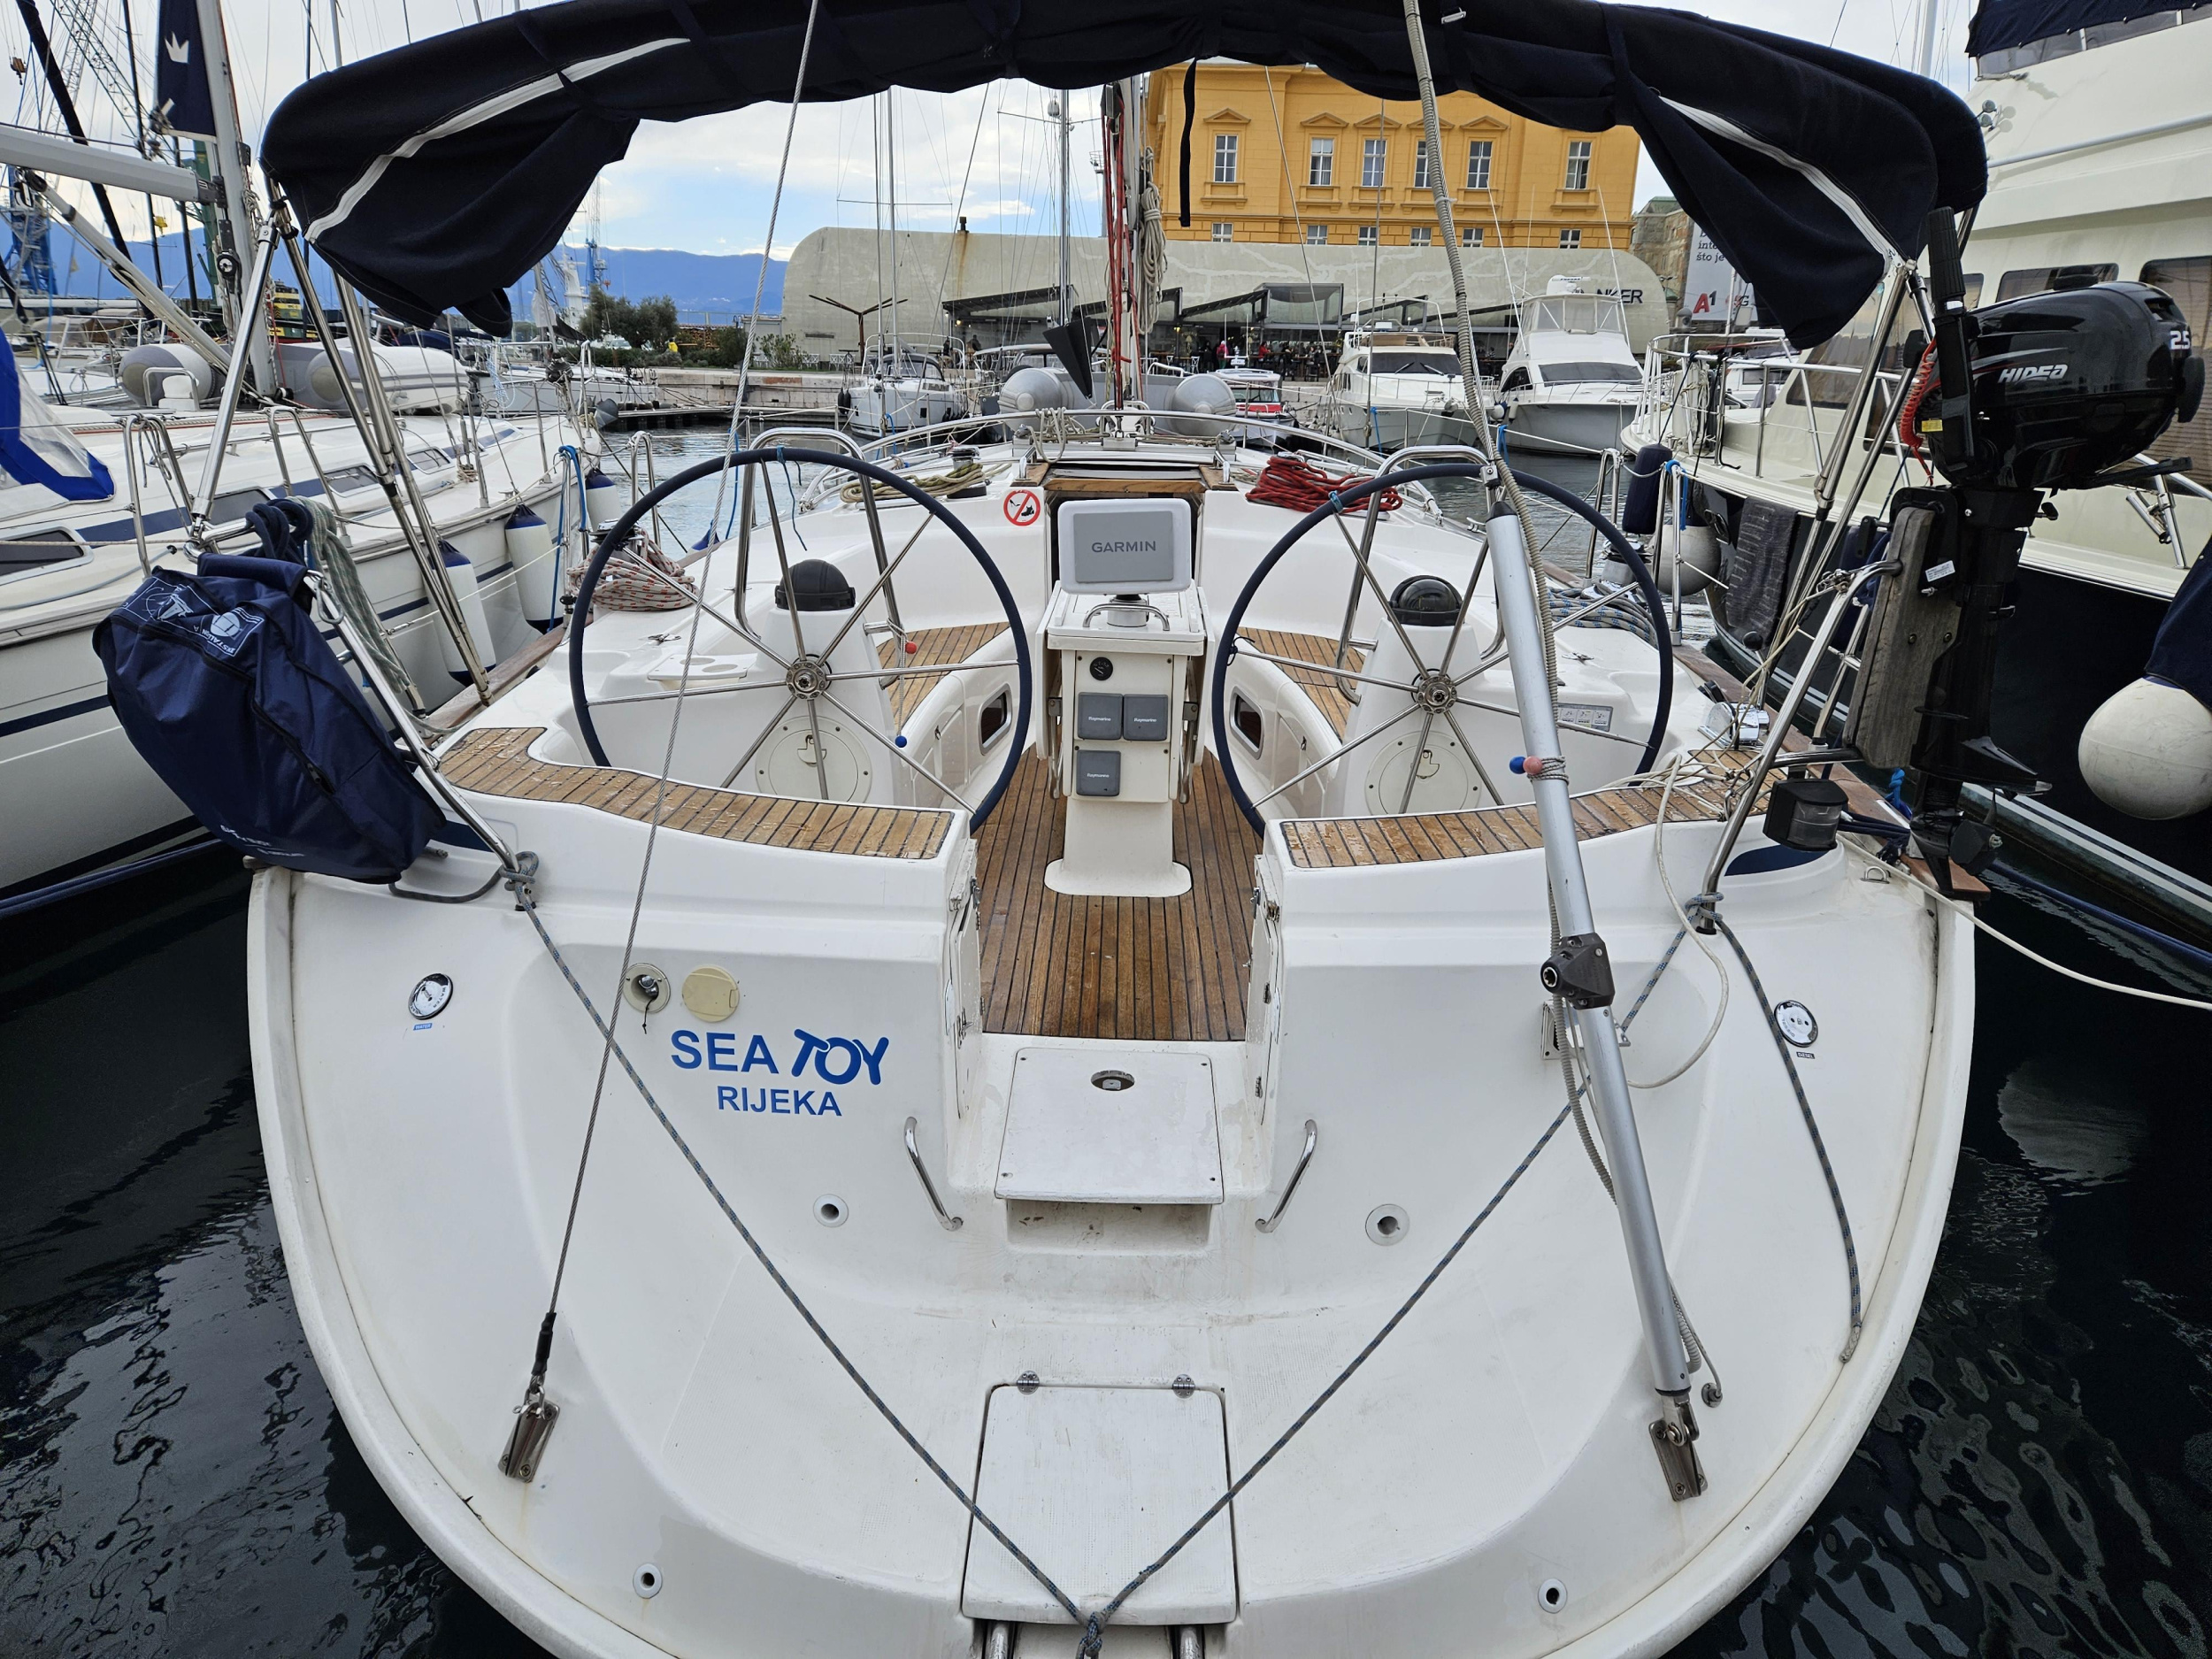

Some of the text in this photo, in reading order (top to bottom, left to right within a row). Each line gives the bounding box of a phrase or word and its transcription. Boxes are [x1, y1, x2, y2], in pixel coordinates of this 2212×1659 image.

[1696, 251, 1725, 264] što je
[1693, 290, 1717, 313] A1
[1091, 541, 1156, 553] GARMIN
[671, 1028, 890, 1086] SEA TOY
[717, 1086, 842, 1117] RIJEKA
